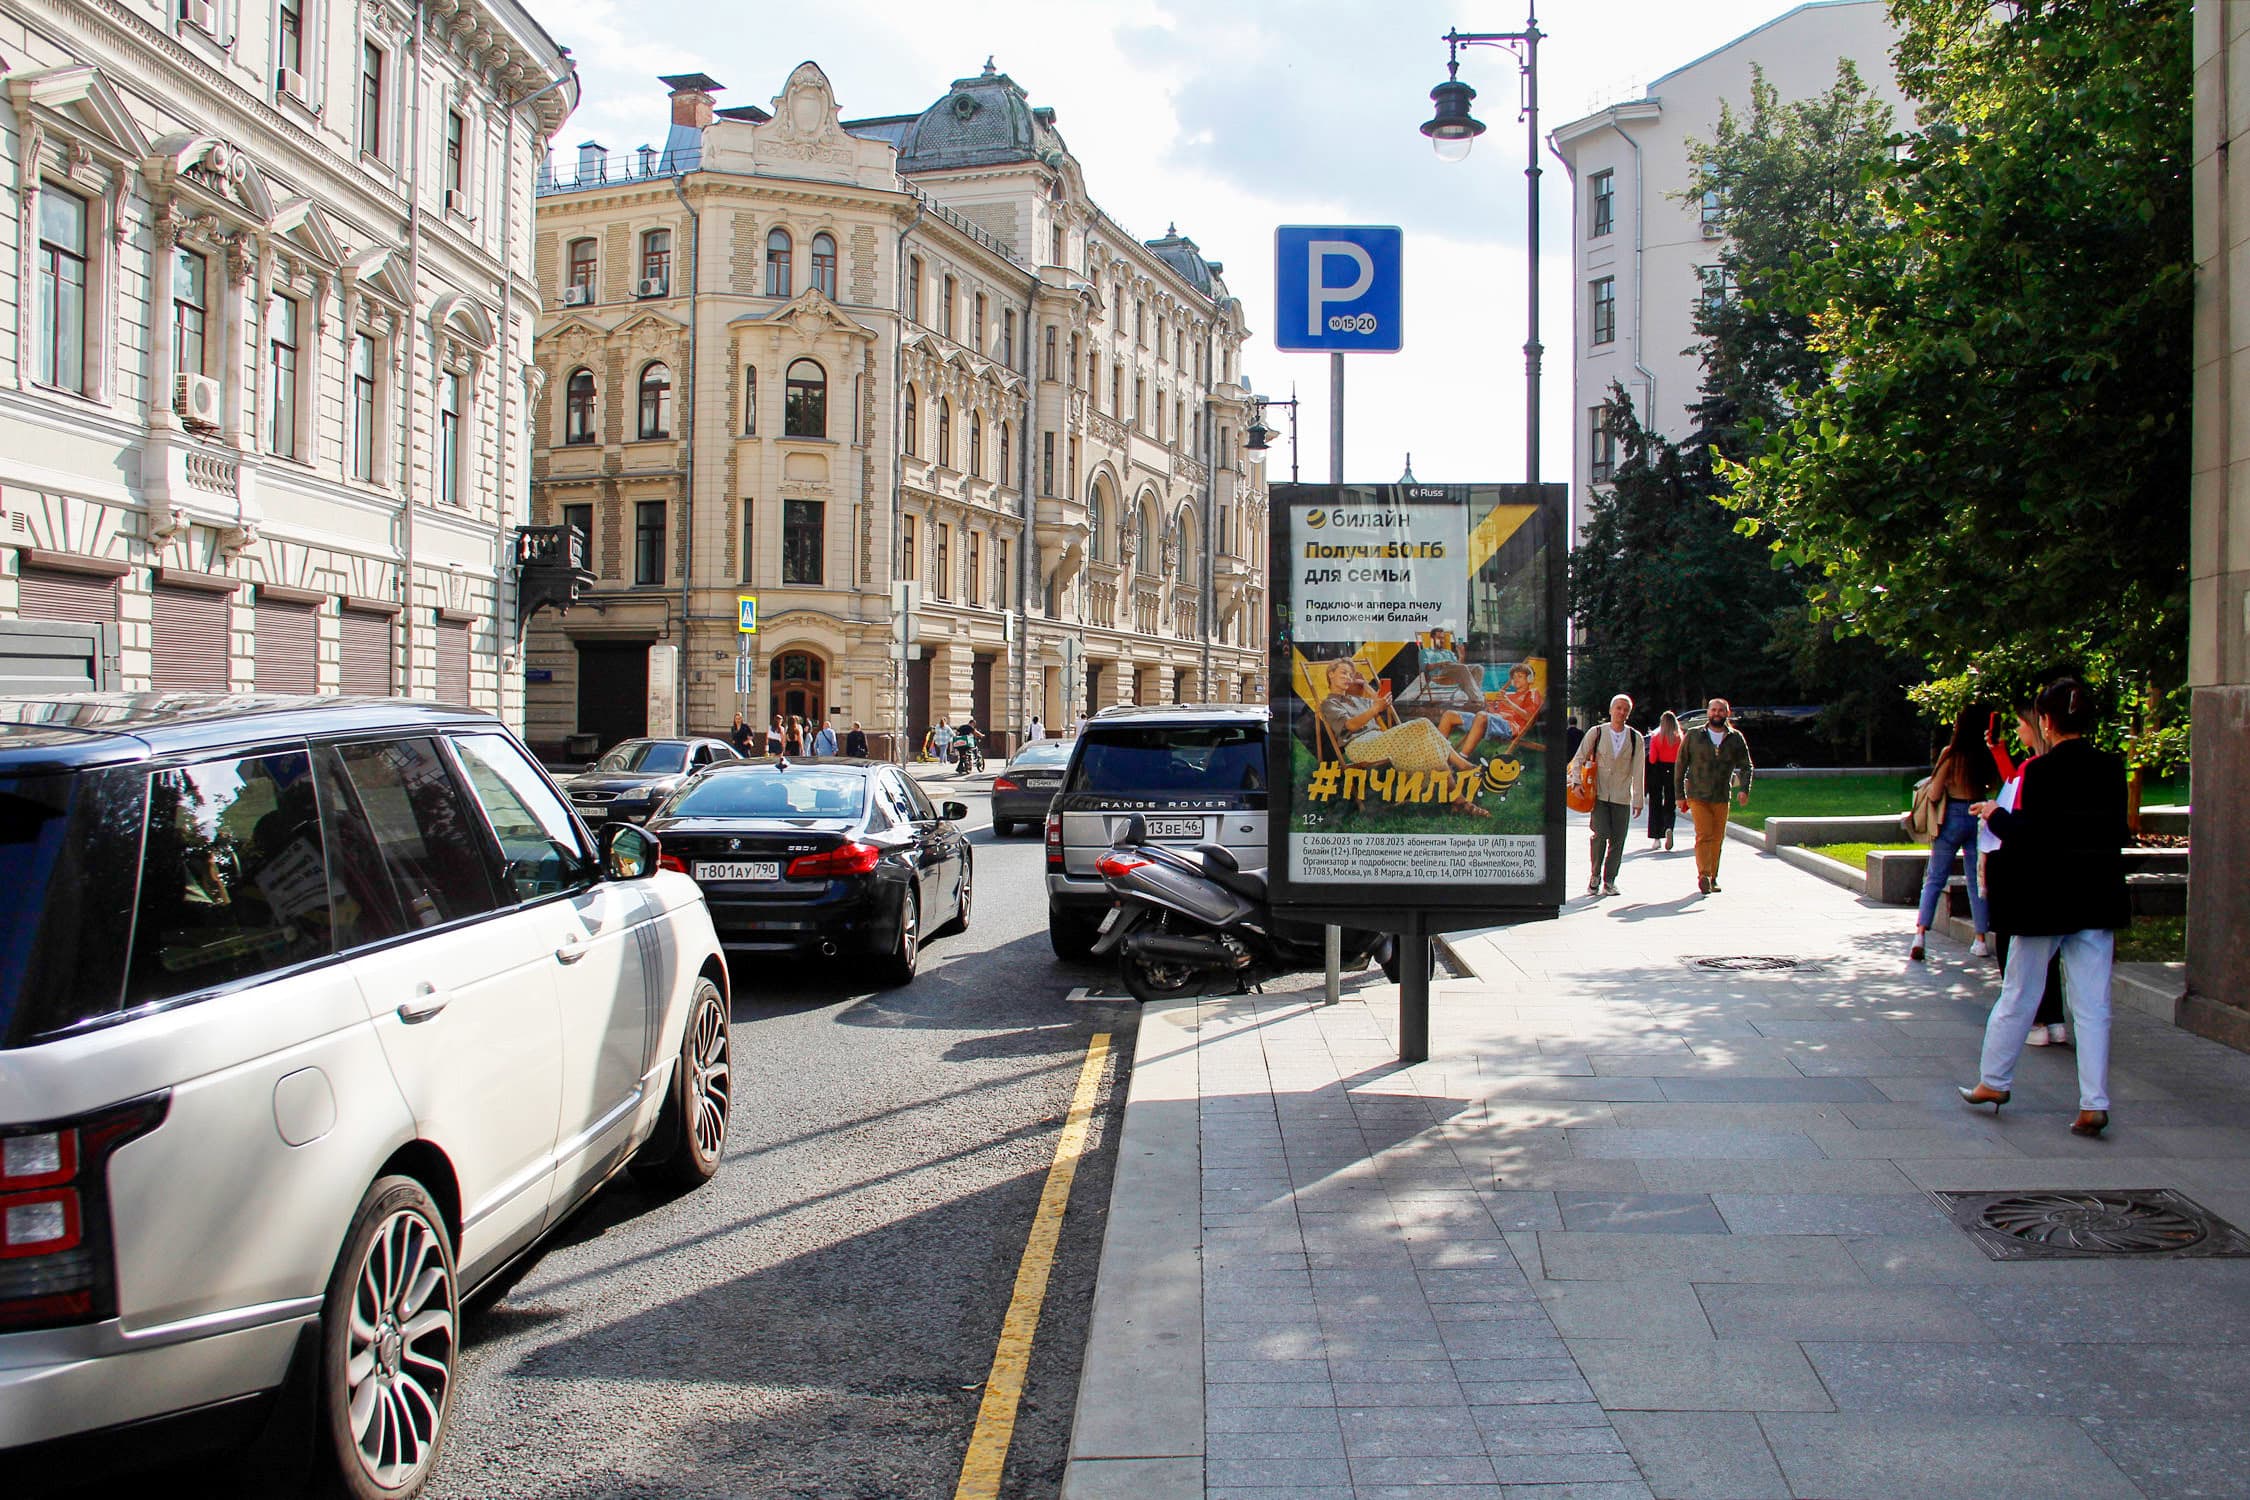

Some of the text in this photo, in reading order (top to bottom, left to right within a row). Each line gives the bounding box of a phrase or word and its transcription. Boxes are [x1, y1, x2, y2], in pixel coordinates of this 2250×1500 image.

[1308, 240, 1374, 336] P
[1331, 318, 1375, 330] 10 15 20
[1420, 488, 1444, 497] Russ
[1332, 508, 1410, 528] билайн
[1305, 541, 1444, 563] Получи 50 Гб
[1304, 568, 1411, 585] для семьи
[1305, 600, 1364, 611] Подключи
[1408, 602, 1442, 612] пчелу
[1305, 612, 1428, 625] в приложении билайн
[1101, 800, 1227, 809] RANGE ROVER
[1302, 814, 1324, 825] 12+
[1148, 820, 1198, 835] 13ВЕ 46
[1311, 836, 1351, 846] 26.06.2023
[1365, 837, 1405, 846] 27.08.2023
[1407, 838, 1447, 847] абонентам
[1449, 838, 1476, 848] Тарифа
[1478, 838, 1489, 847] UP
[1302, 846, 1330, 855] билайн
[1351, 847, 1402, 857] Предложение
[1413, 848, 1467, 858] действительно
[1483, 849, 1523, 858] Чукотского
[1302, 856, 1349, 868] Организатор
[1359, 858, 1409, 868] подробности:
[1449, 858, 1466, 867] ПАО
[700, 863, 775, 878] Т801АУ 790
[1333, 867, 1363, 877] Москва,
[1374, 868, 1379, 877] 8
[1452, 868, 1472, 878] ОГРН
